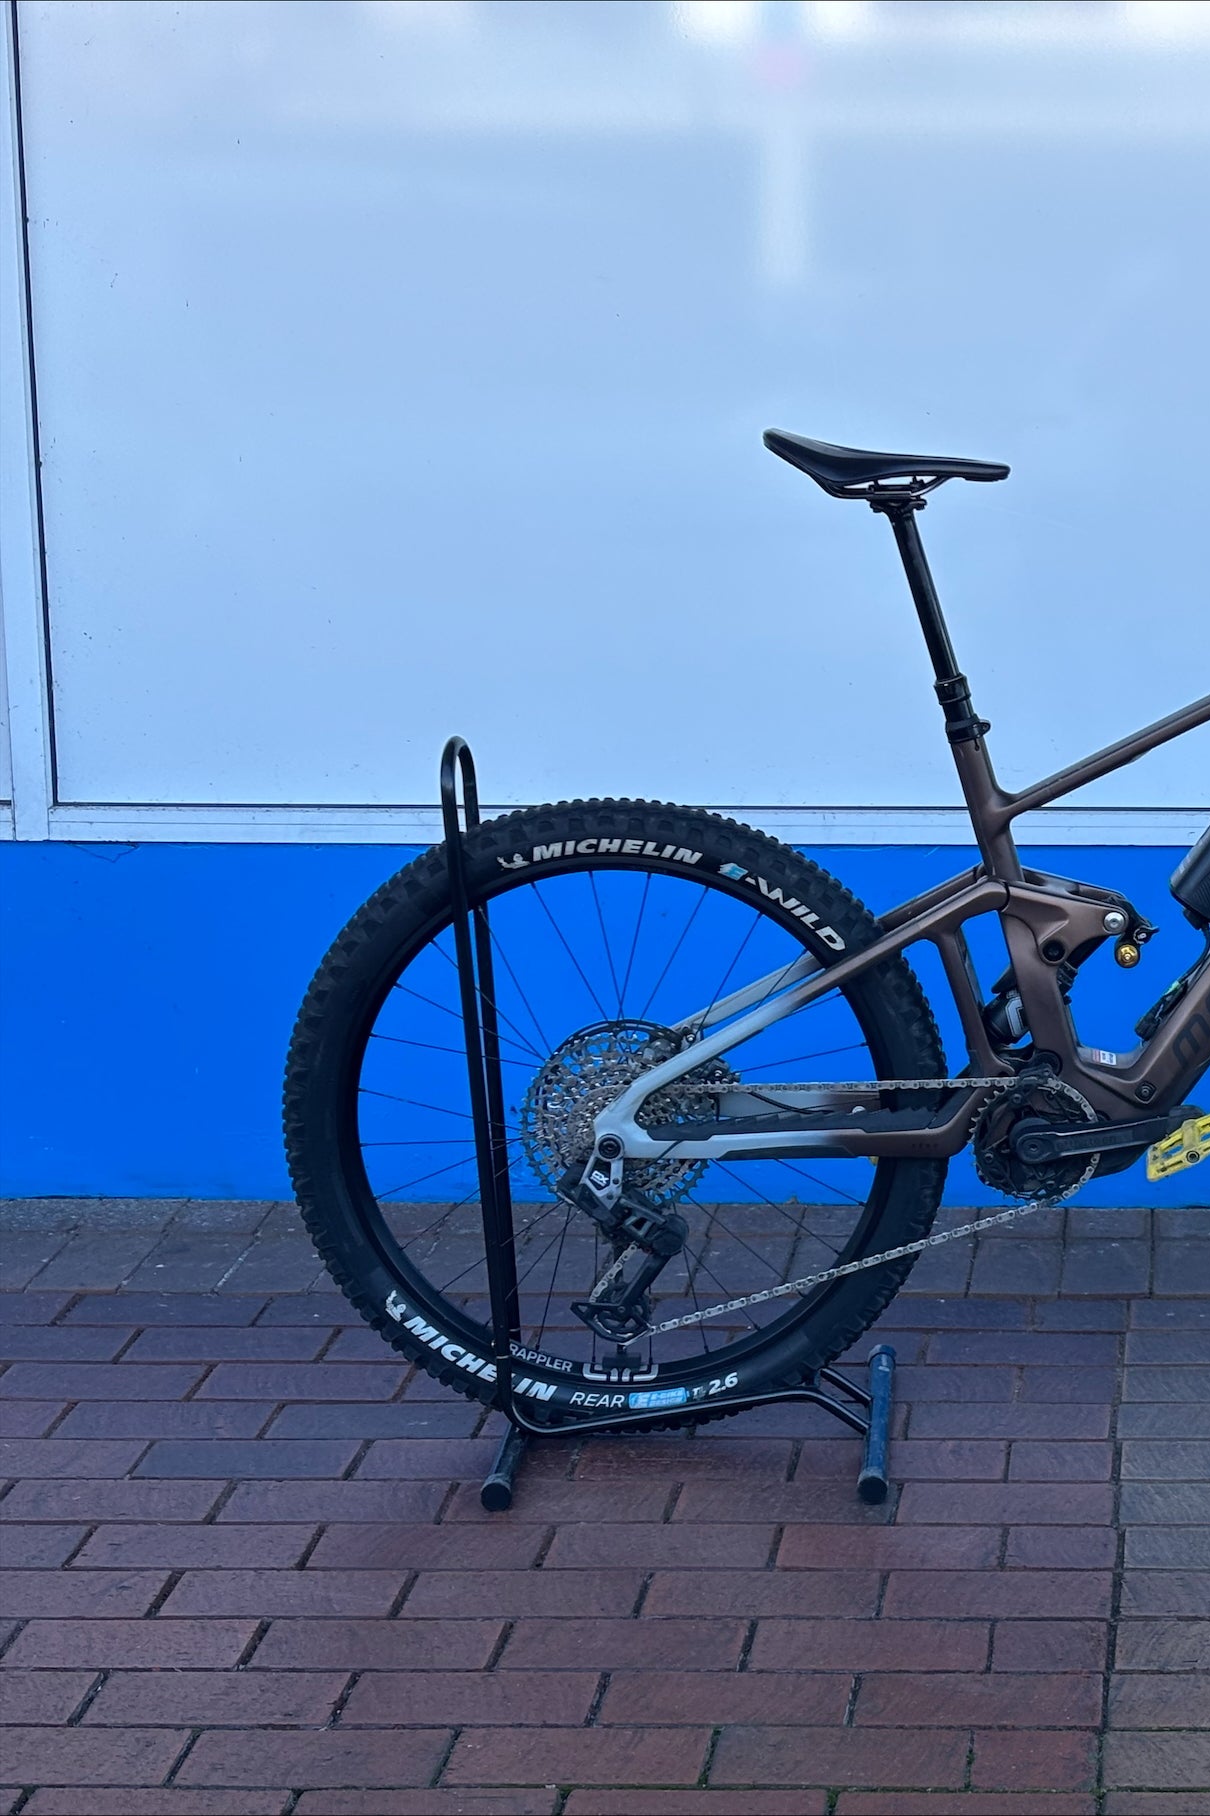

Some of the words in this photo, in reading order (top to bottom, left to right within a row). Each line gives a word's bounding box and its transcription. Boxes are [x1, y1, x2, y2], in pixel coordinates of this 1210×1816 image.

[532, 838, 703, 865] MICHELIN
[718, 861, 846, 952] E-WILD
[403, 1315, 558, 1402] MICHEIN
[569, 1391, 625, 1409] REAR
[509, 1343, 573, 1372] RAPPLER
[708, 1371, 739, 1397] 2.6
